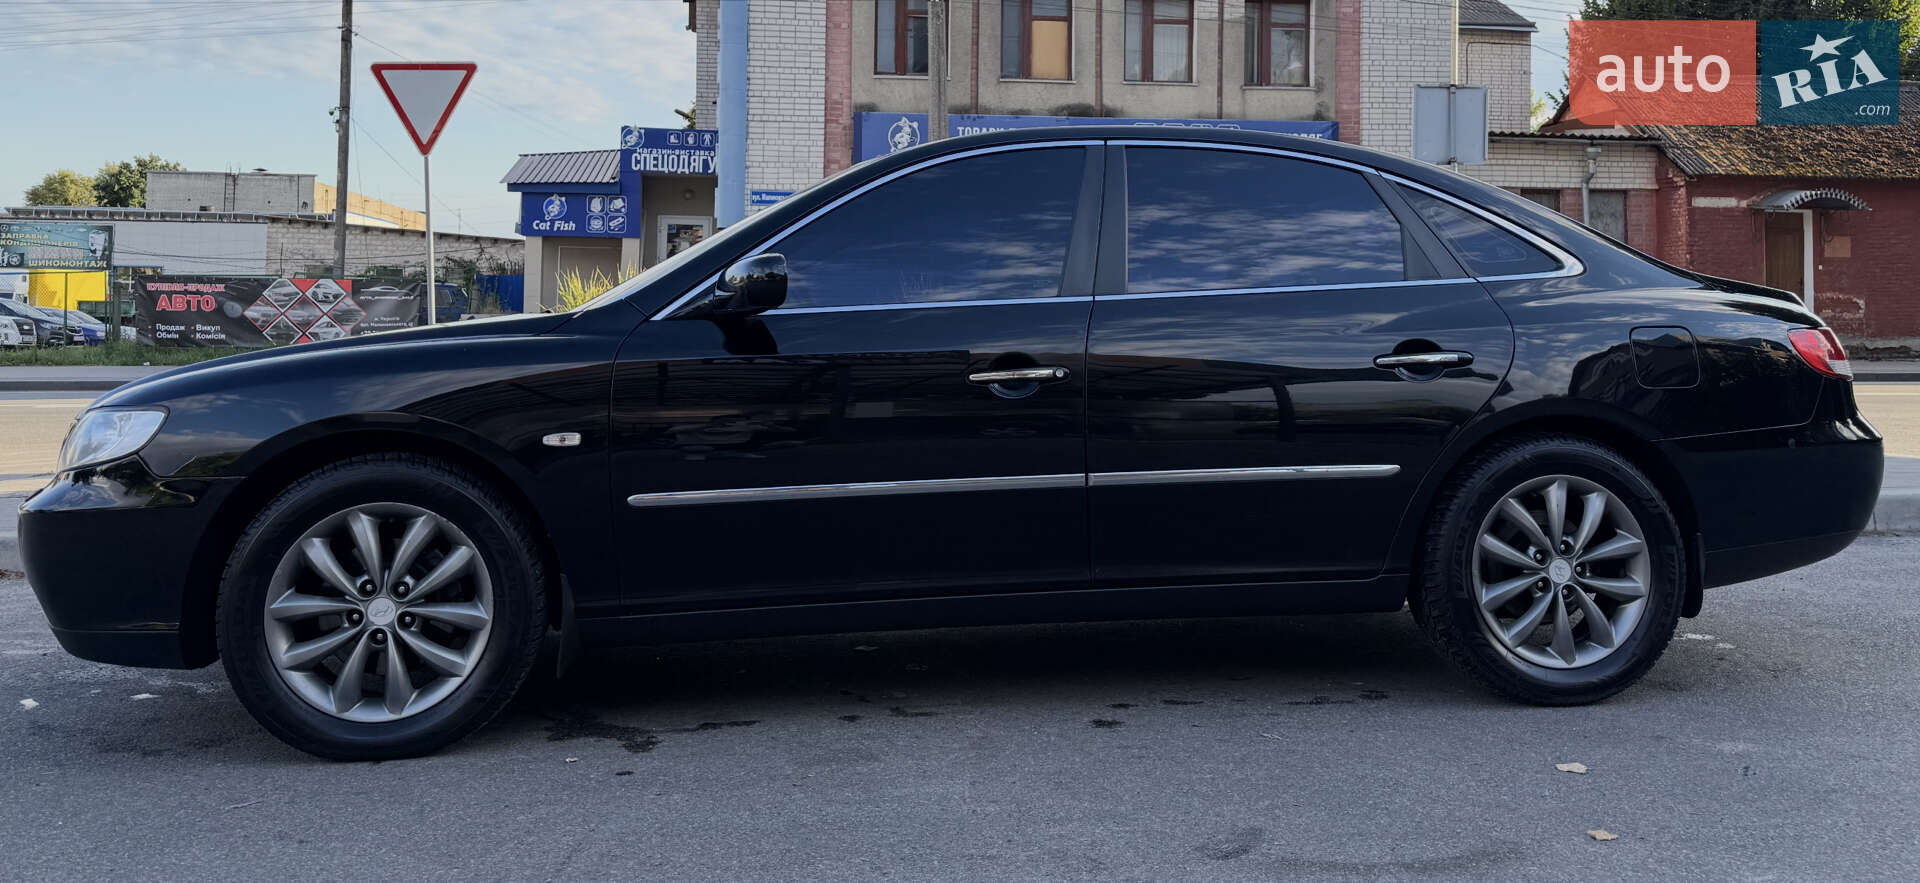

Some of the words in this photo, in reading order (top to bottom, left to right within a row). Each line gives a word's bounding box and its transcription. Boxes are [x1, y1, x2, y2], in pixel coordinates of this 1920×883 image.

[631, 153, 716, 174] СПЕЦОДЯГУ
[532, 220, 550, 230] Cat
[553, 220, 576, 231] Fish
[29, 260, 107, 268] ШИНОМОНТАЖ
[156, 295, 215, 312] АВТО
[196, 324, 221, 332] Викуп
